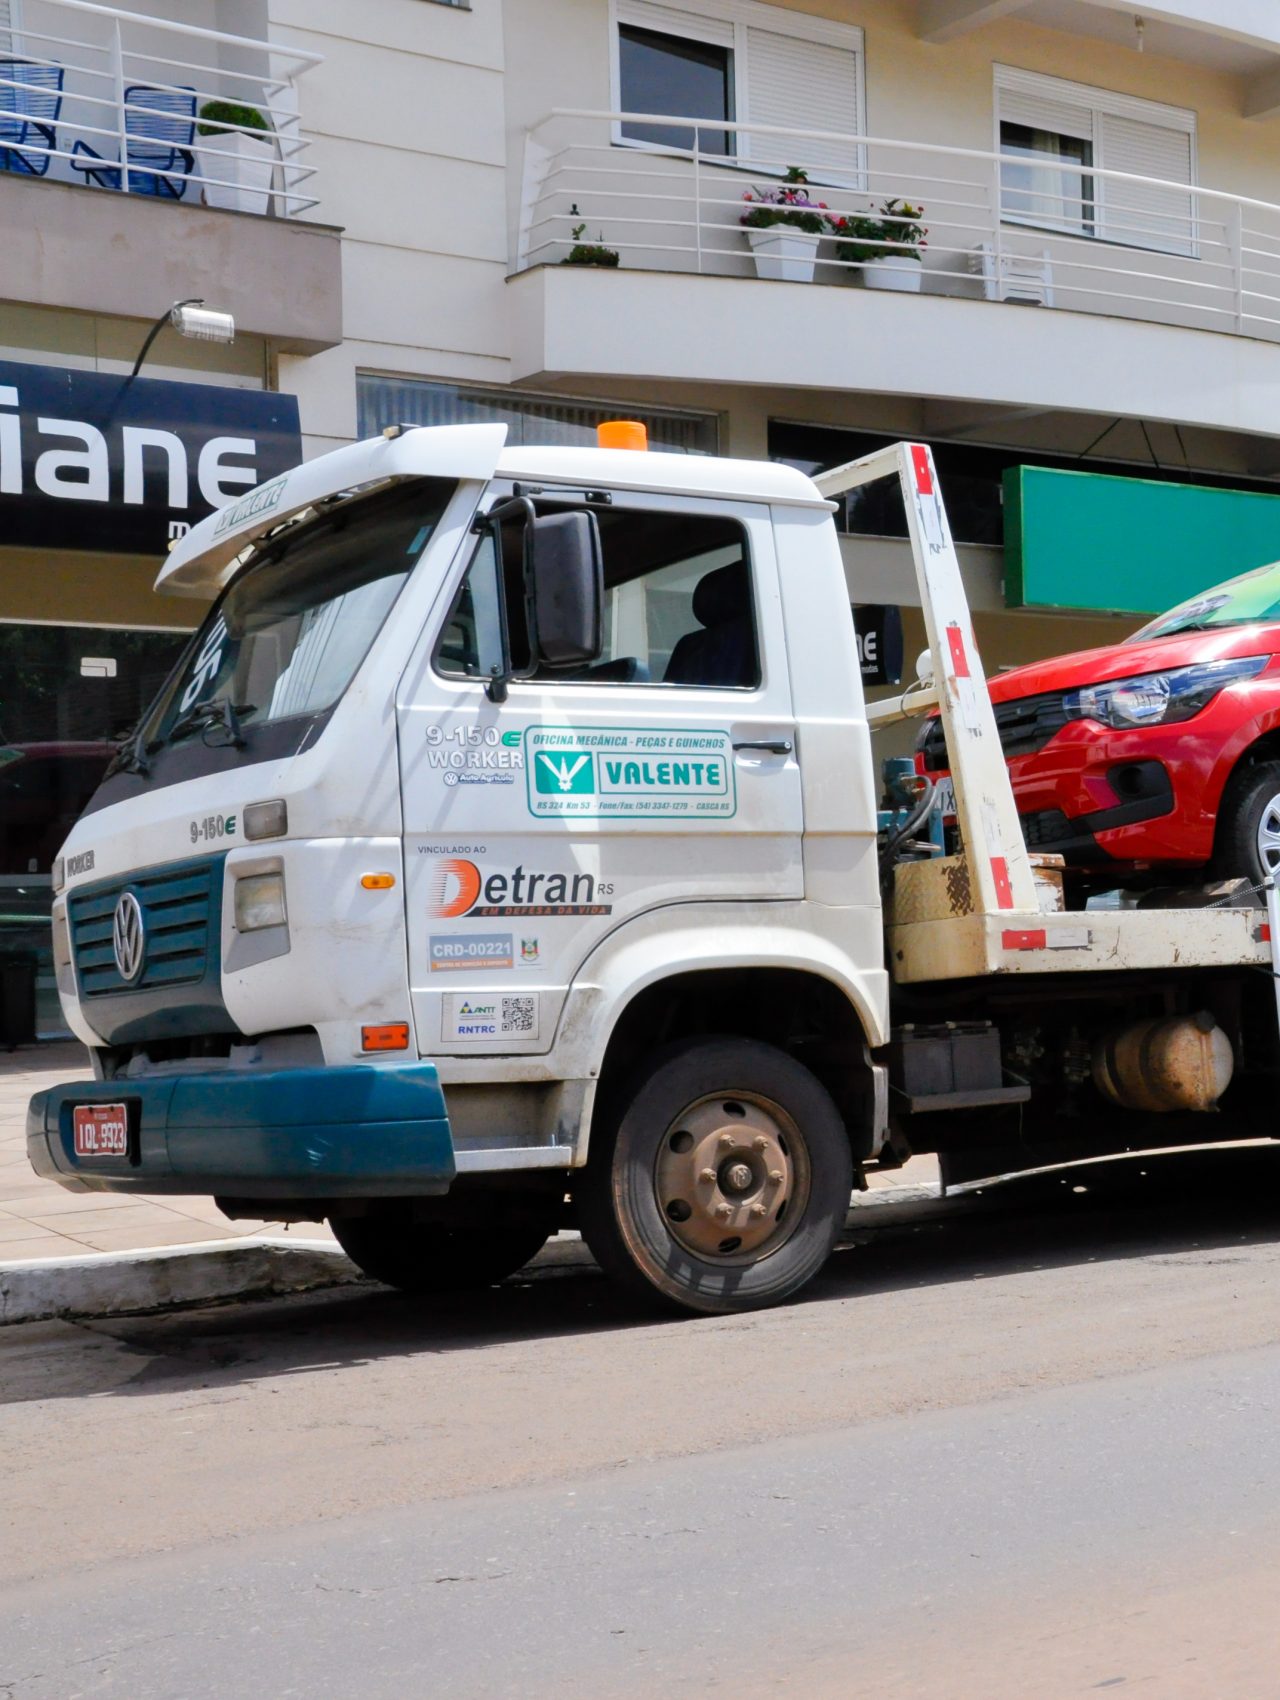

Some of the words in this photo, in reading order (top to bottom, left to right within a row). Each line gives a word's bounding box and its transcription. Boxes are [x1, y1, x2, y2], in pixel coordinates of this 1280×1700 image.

[533, 734, 574, 746] OFICINA
[576, 734, 628, 747] MECÂNICA
[635, 737, 666, 748] PEÇAS
[668, 737, 674, 747] E
[676, 738, 725, 749] GUINCHOS
[429, 751, 525, 769] WORKER
[606, 762, 720, 786] VALENTE
[537, 801, 548, 810] RS
[696, 802, 719, 810] CASCA
[418, 846, 471, 854] VINCULADO
[473, 846, 487, 854] AO
[67, 850, 95, 878] WORKER
[425, 858, 595, 919] Detran
[597, 884, 615, 895] RS
[480, 907, 499, 916] EM
[504, 907, 551, 915] DEFESA
[557, 906, 573, 914] DA
[578, 906, 608, 914] VIDA
[433, 942, 511, 957] CRD-00221
[458, 1025, 496, 1034] RNTRC
